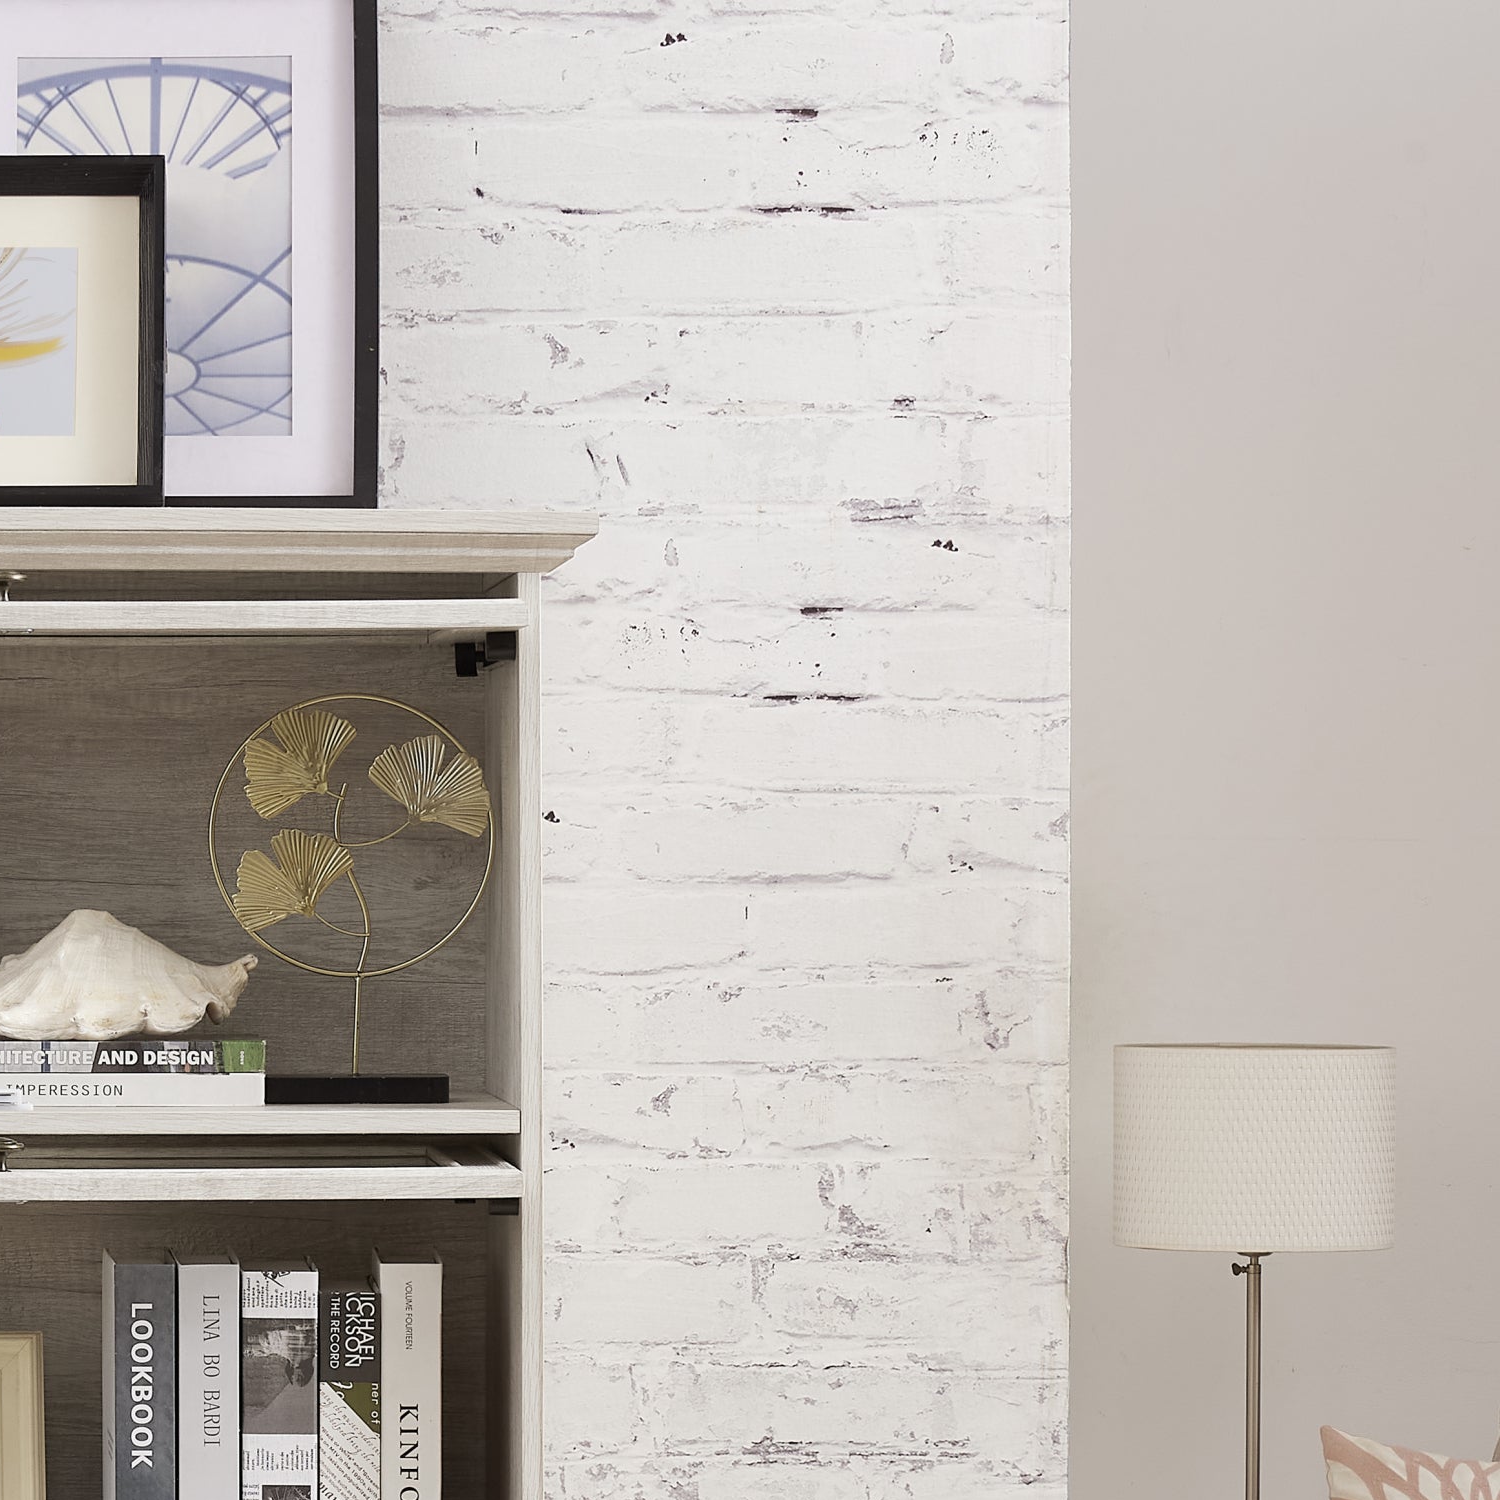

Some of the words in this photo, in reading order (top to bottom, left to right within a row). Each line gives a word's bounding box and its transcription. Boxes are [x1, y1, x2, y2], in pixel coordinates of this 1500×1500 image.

[98, 1050, 138, 1066] AND
[143, 1050, 215, 1066] DESIGN
[203, 1294, 220, 1342] LINA
[330, 1297, 341, 1317] THE
[203, 1354, 221, 1379] BO
[330, 1319, 340, 1369] RECORD
[130, 1302, 154, 1469] LOOKBOOK
[203, 1390, 221, 1447] BARDI
